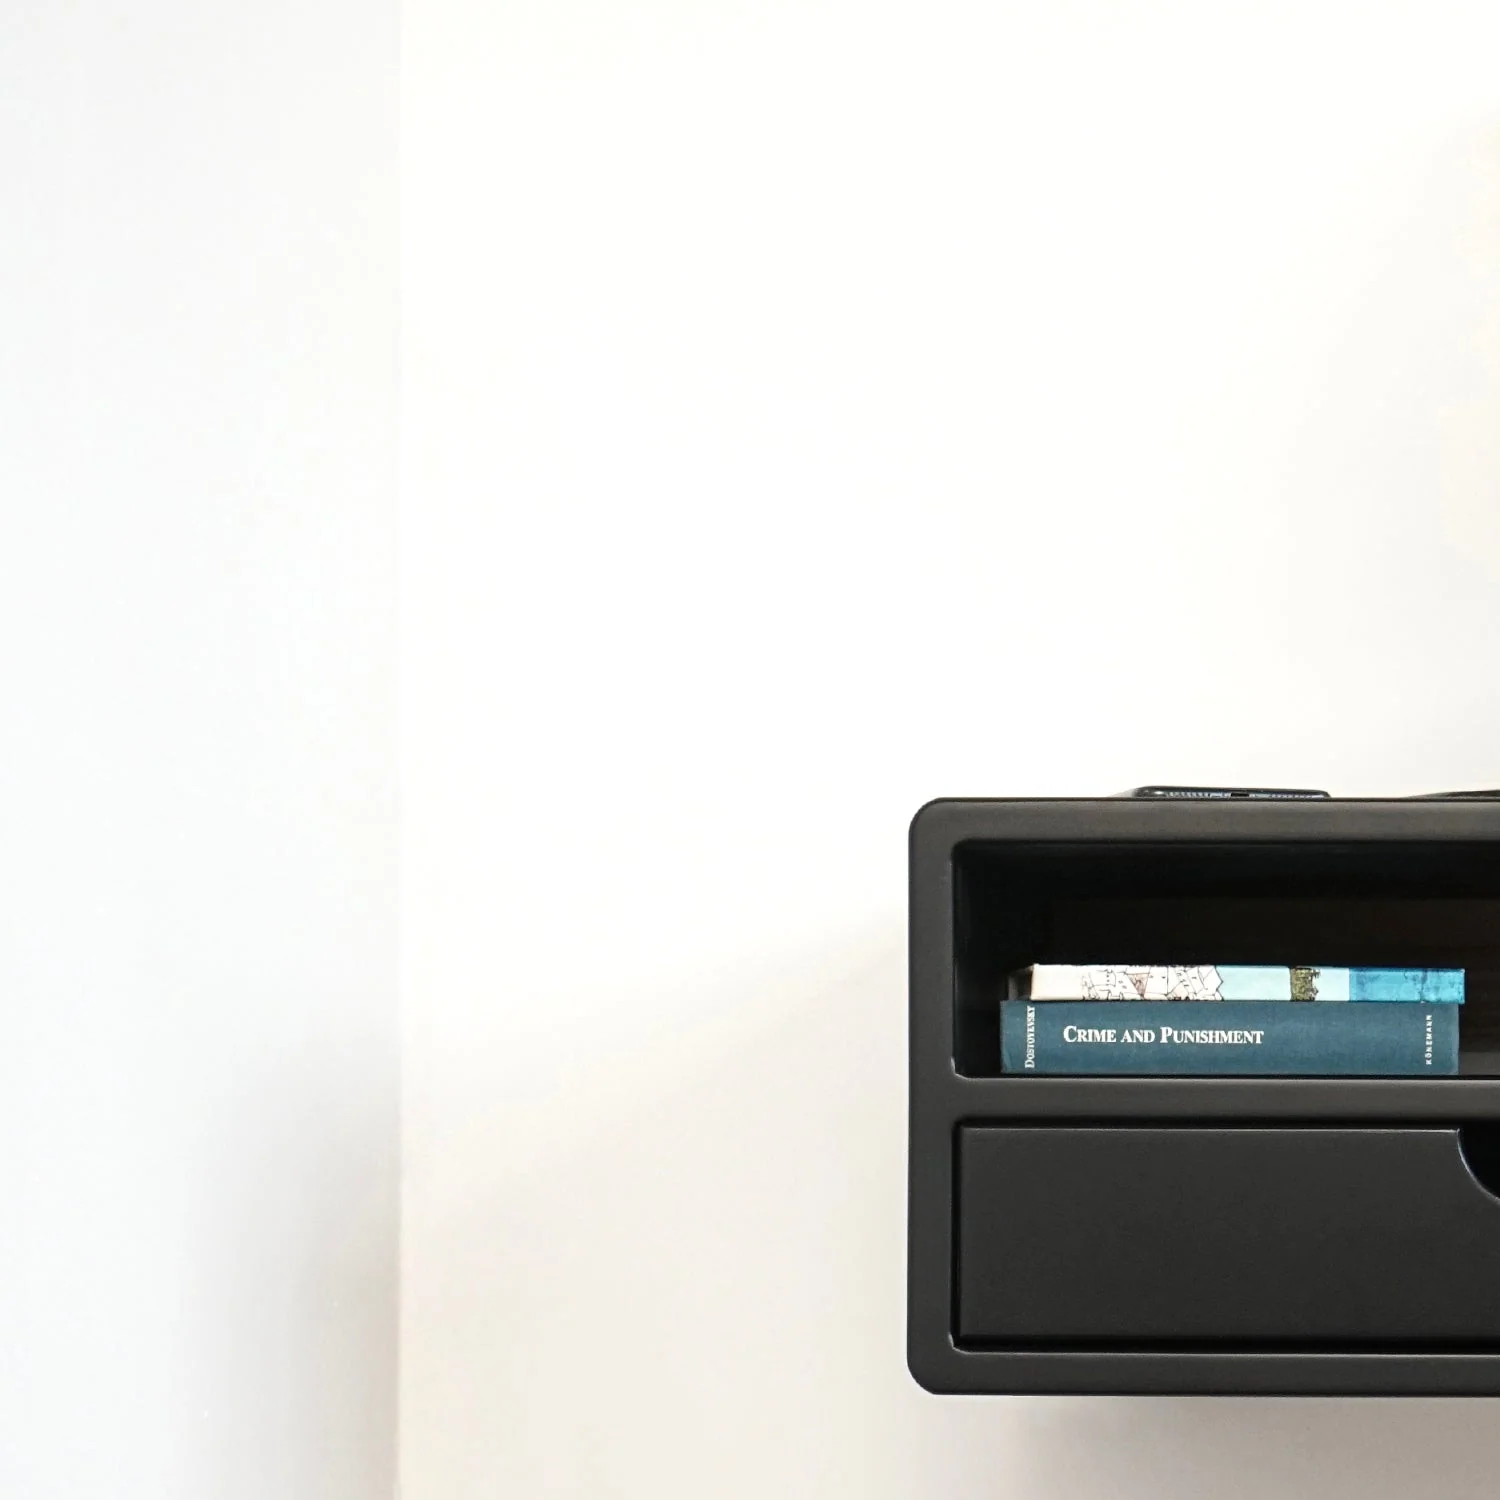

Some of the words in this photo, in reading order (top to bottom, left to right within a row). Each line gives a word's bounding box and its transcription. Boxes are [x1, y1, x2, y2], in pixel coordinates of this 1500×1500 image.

[1024, 1005, 1036, 1069] DOSTOYEVSKY
[1062, 1025, 1117, 1044] CRIME
[1120, 1028, 1156, 1044] AND
[1159, 1025, 1265, 1045] PUNISHMENT
